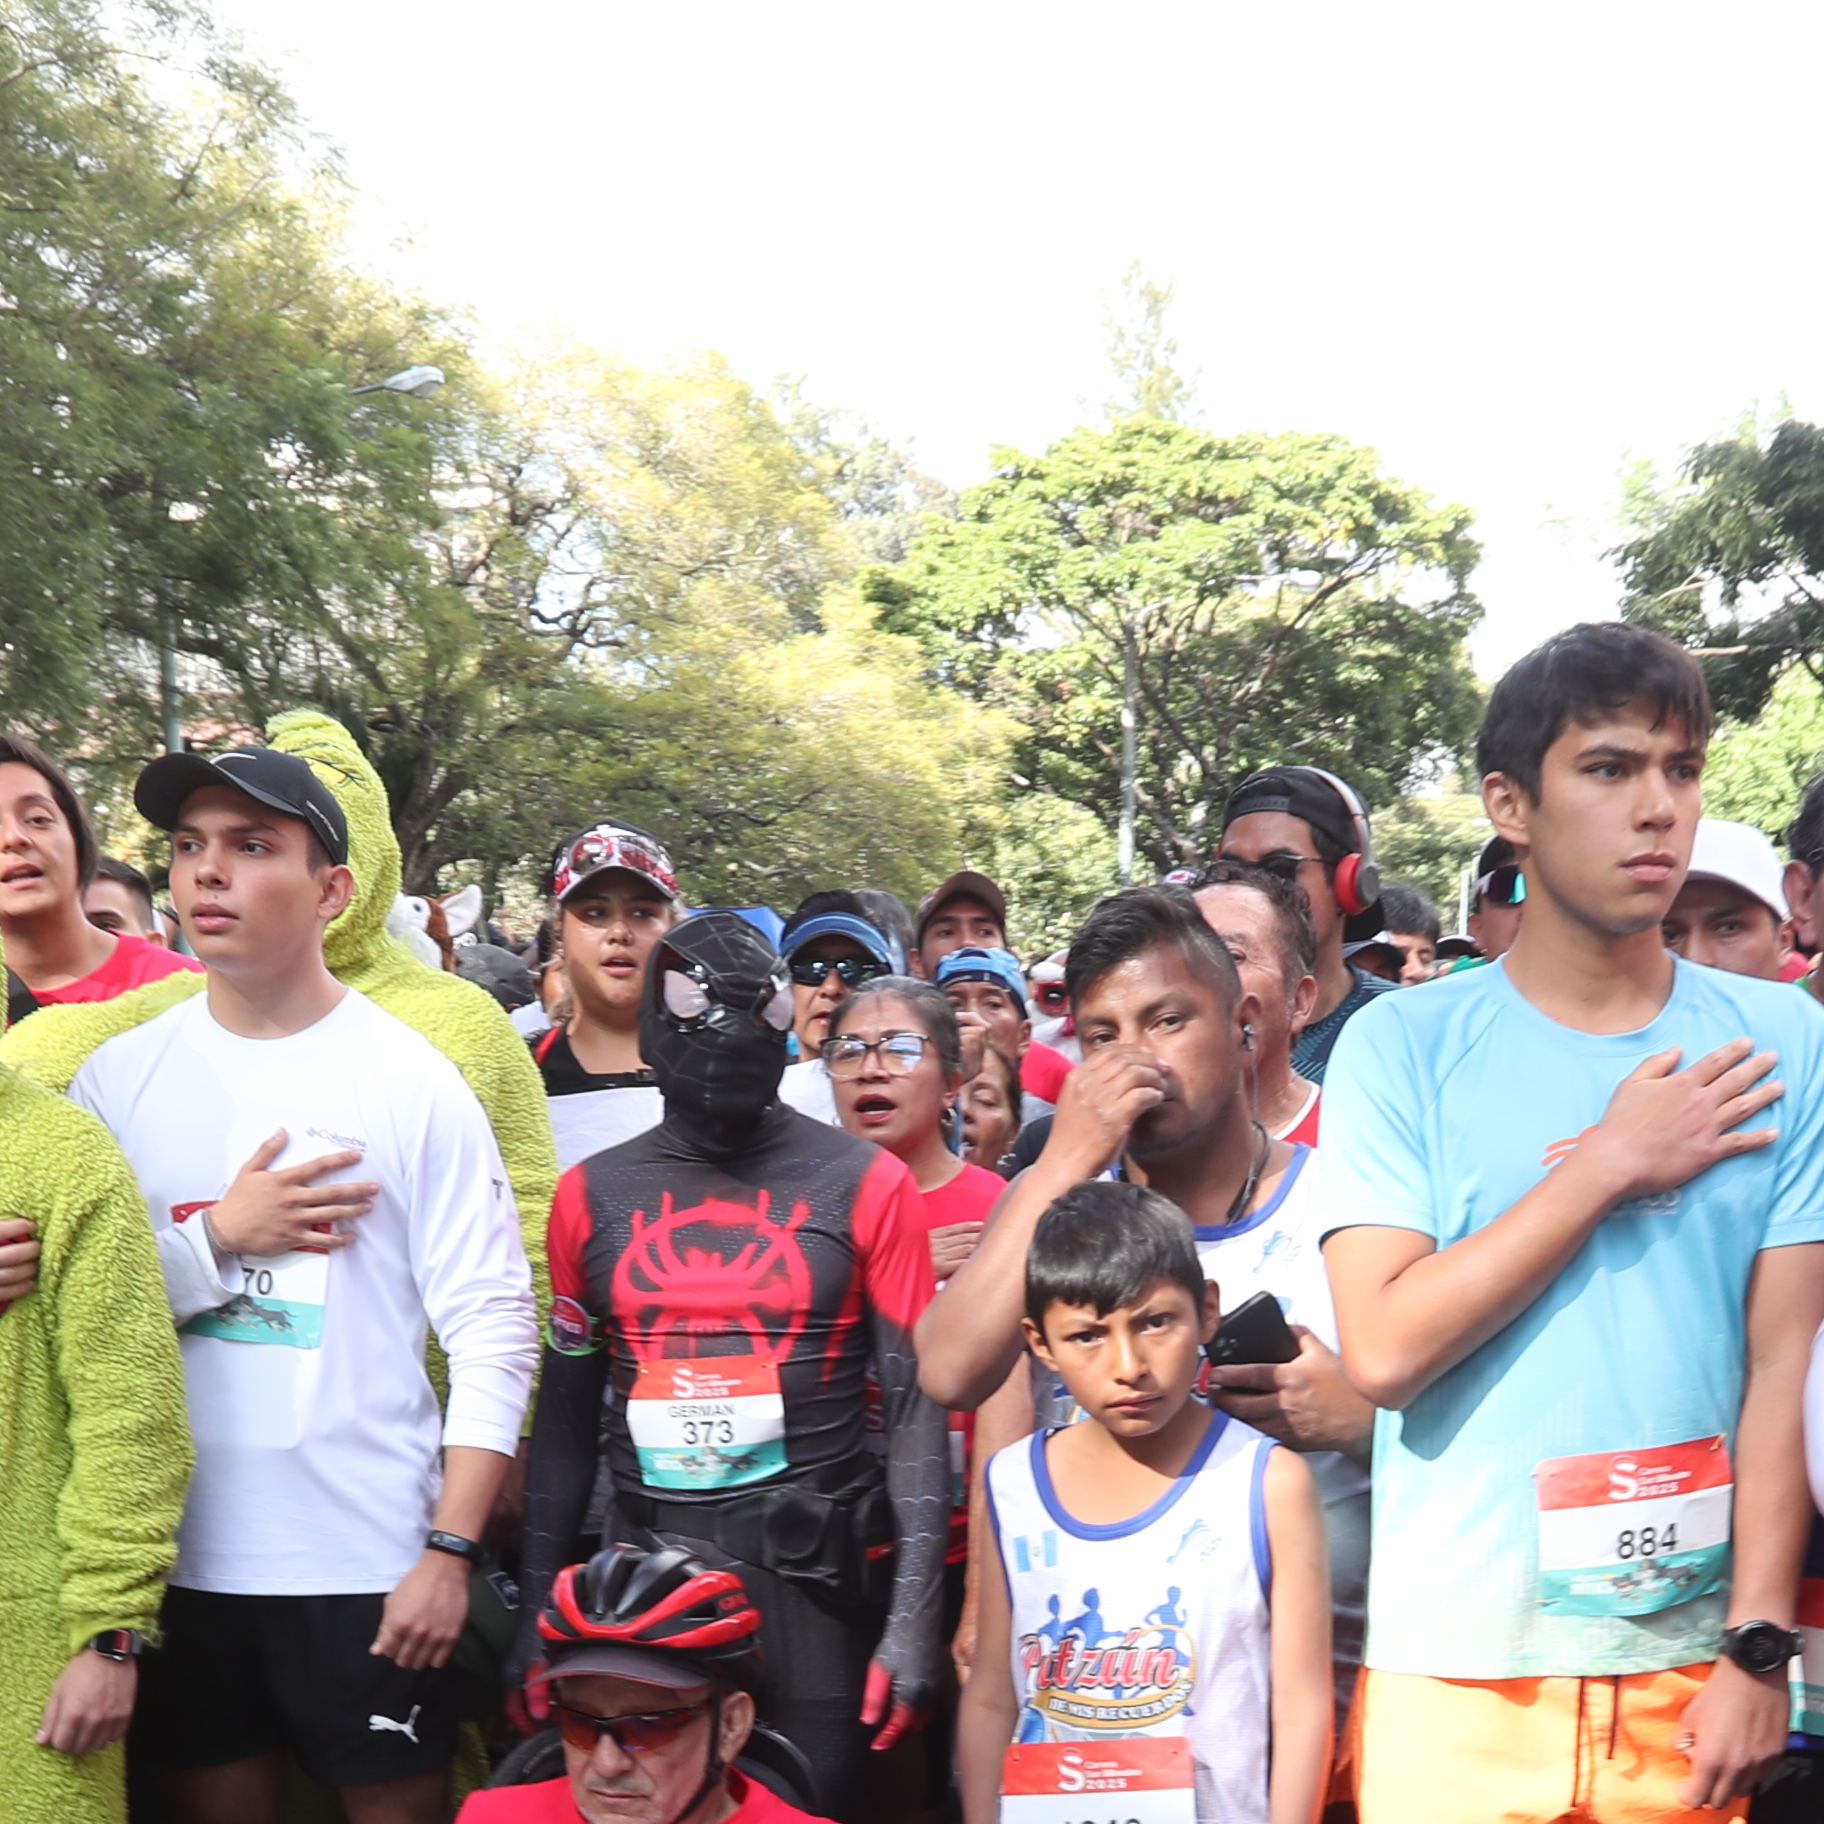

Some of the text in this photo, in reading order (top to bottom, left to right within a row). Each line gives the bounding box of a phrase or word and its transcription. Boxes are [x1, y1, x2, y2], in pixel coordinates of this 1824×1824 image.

[241, 1266, 274, 1296] 70
[667, 1403, 737, 1418] GERMAN
[682, 1420, 735, 1446] 373
[1616, 1521, 1680, 1560] 884
